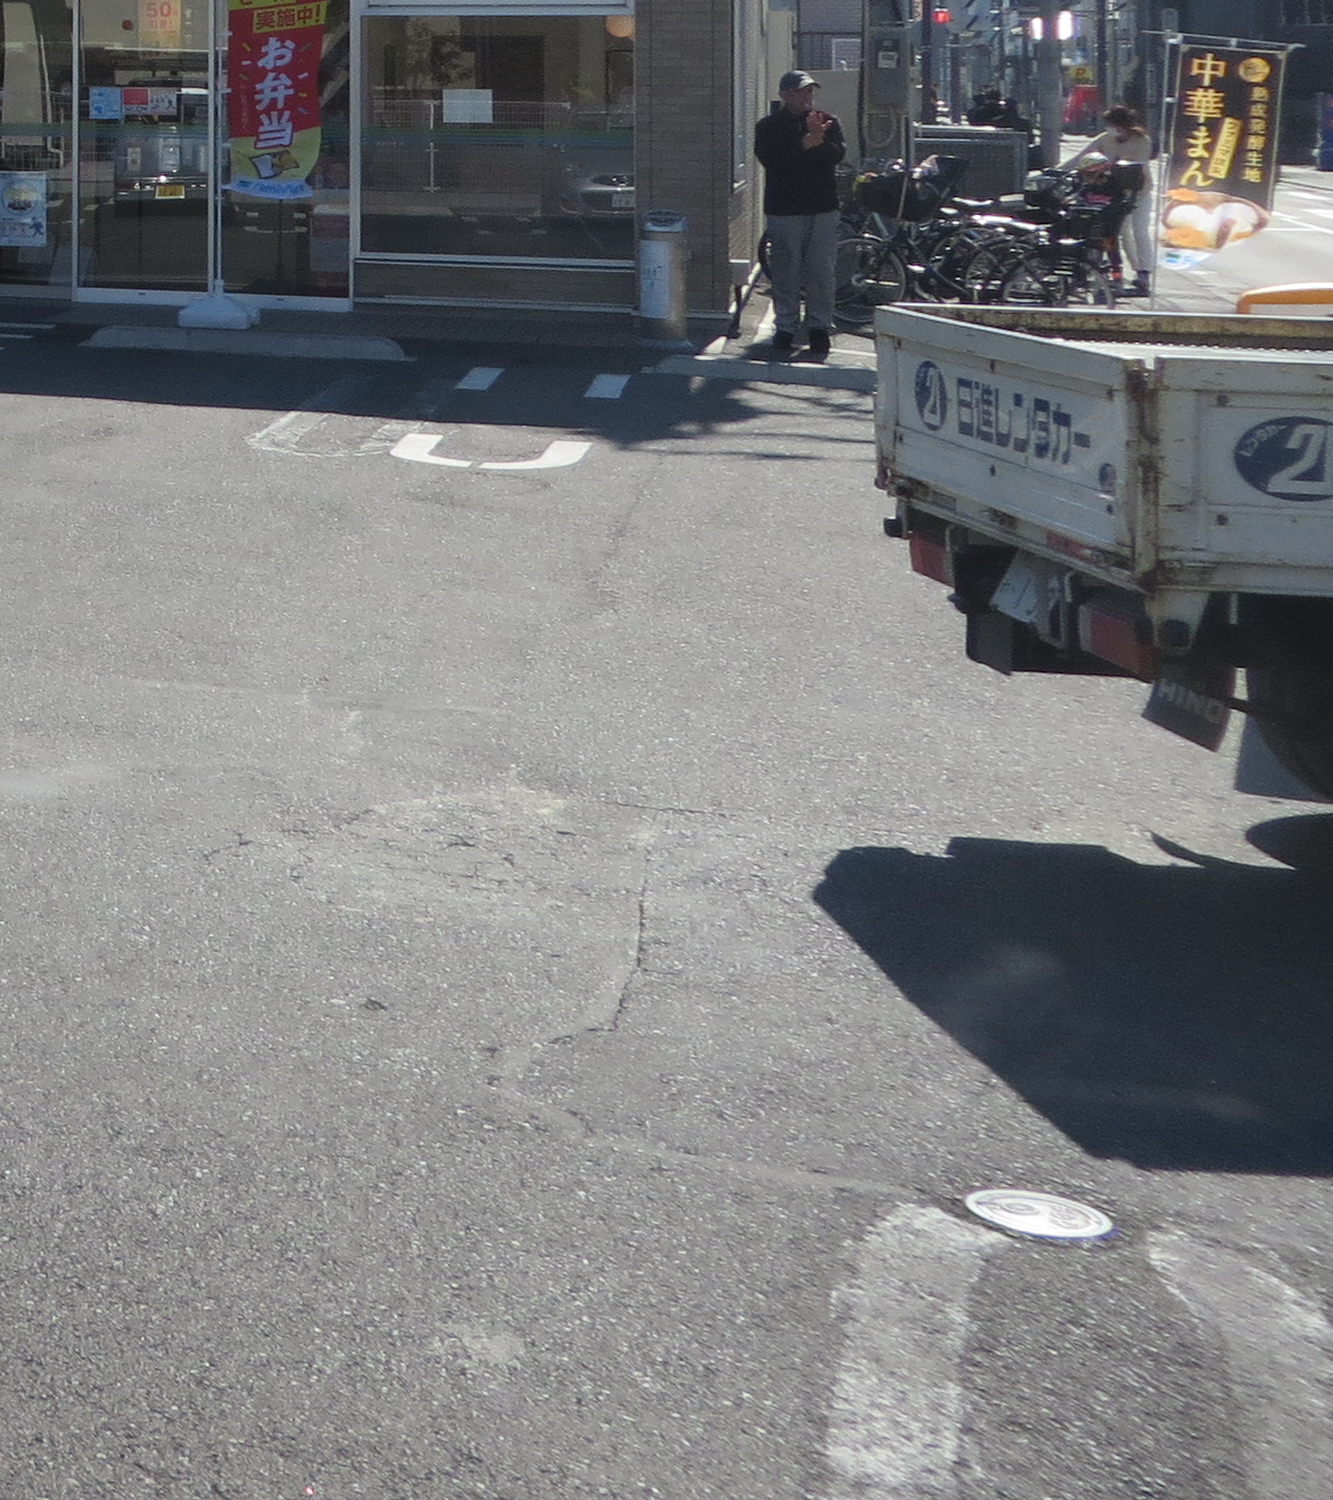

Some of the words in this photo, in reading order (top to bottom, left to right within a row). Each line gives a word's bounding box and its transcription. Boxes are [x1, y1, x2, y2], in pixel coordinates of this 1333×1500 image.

[255, 4, 321, 31] 実施中!
[253, 36, 296, 149] お弁当
[1179, 52, 1227, 188] 中華まん
[957, 376, 1091, 466] 日進レンタカー
[1155, 678, 1227, 725] HINO
